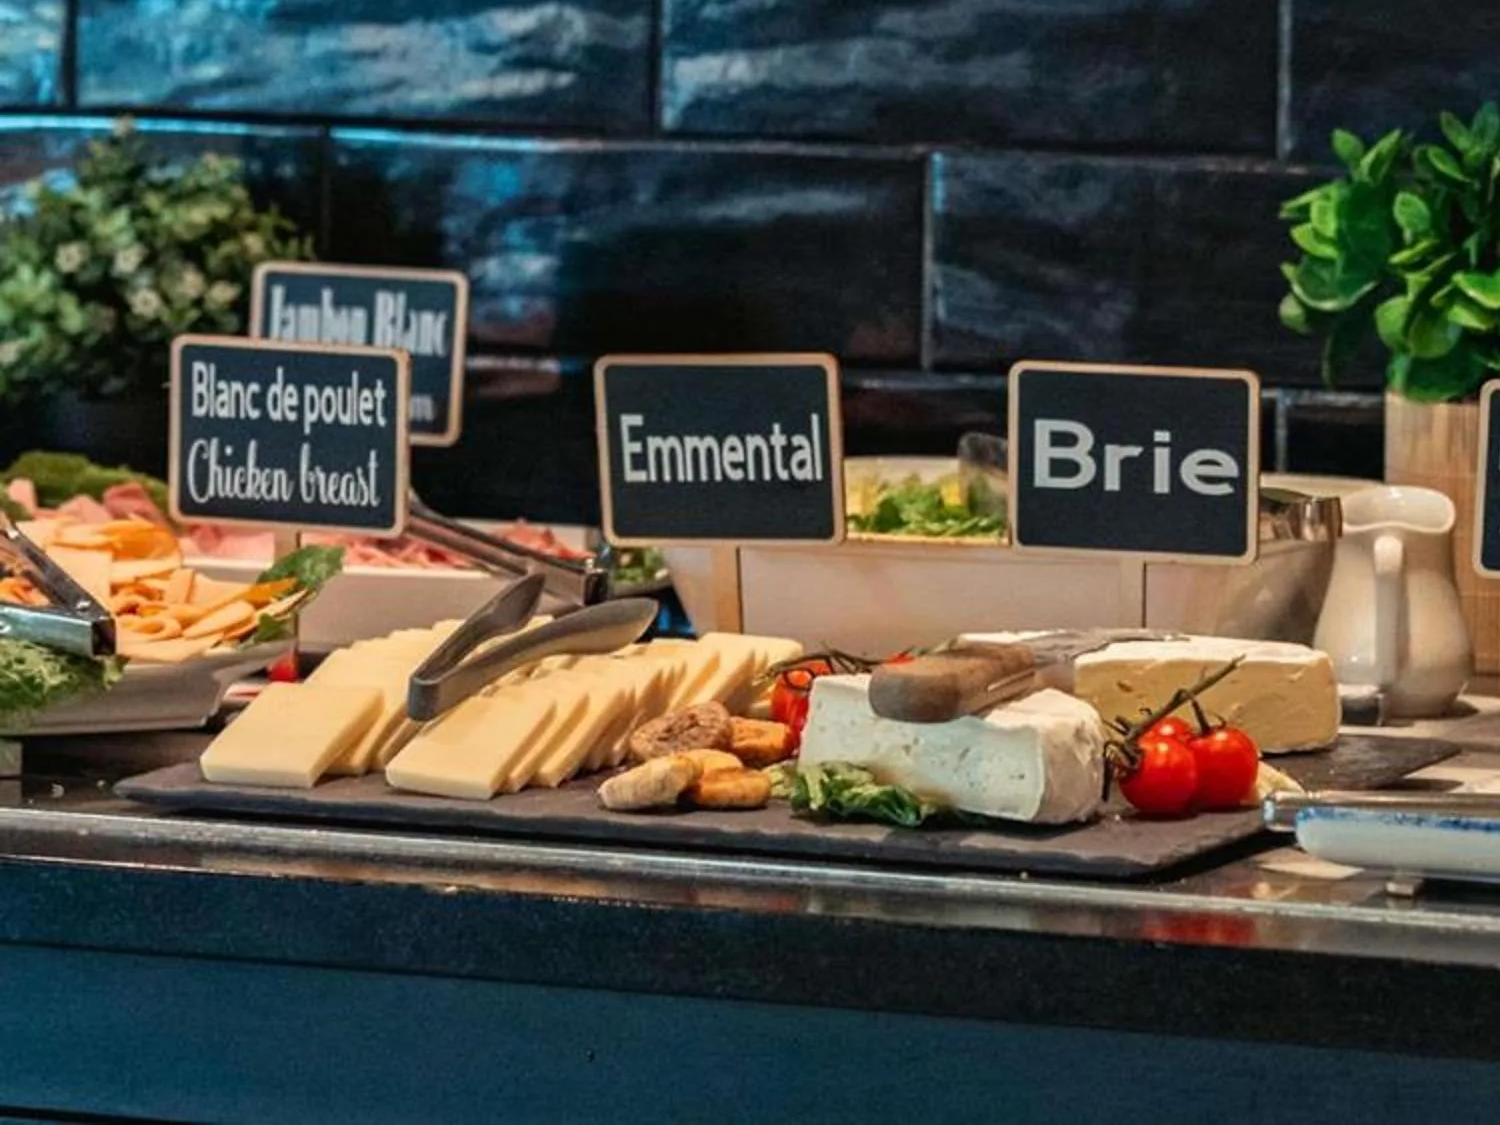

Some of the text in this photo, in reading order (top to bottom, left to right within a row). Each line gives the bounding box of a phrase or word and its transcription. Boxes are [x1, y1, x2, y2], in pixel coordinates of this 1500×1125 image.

[374, 289, 448, 358] Blanc
[192, 361, 260, 420] Blanc
[266, 366, 299, 422] de
[303, 371, 387, 435] poulet
[187, 437, 380, 507] Chicken breast
[619, 412, 823, 483] Emmental
[1033, 418, 1239, 495] Brie
